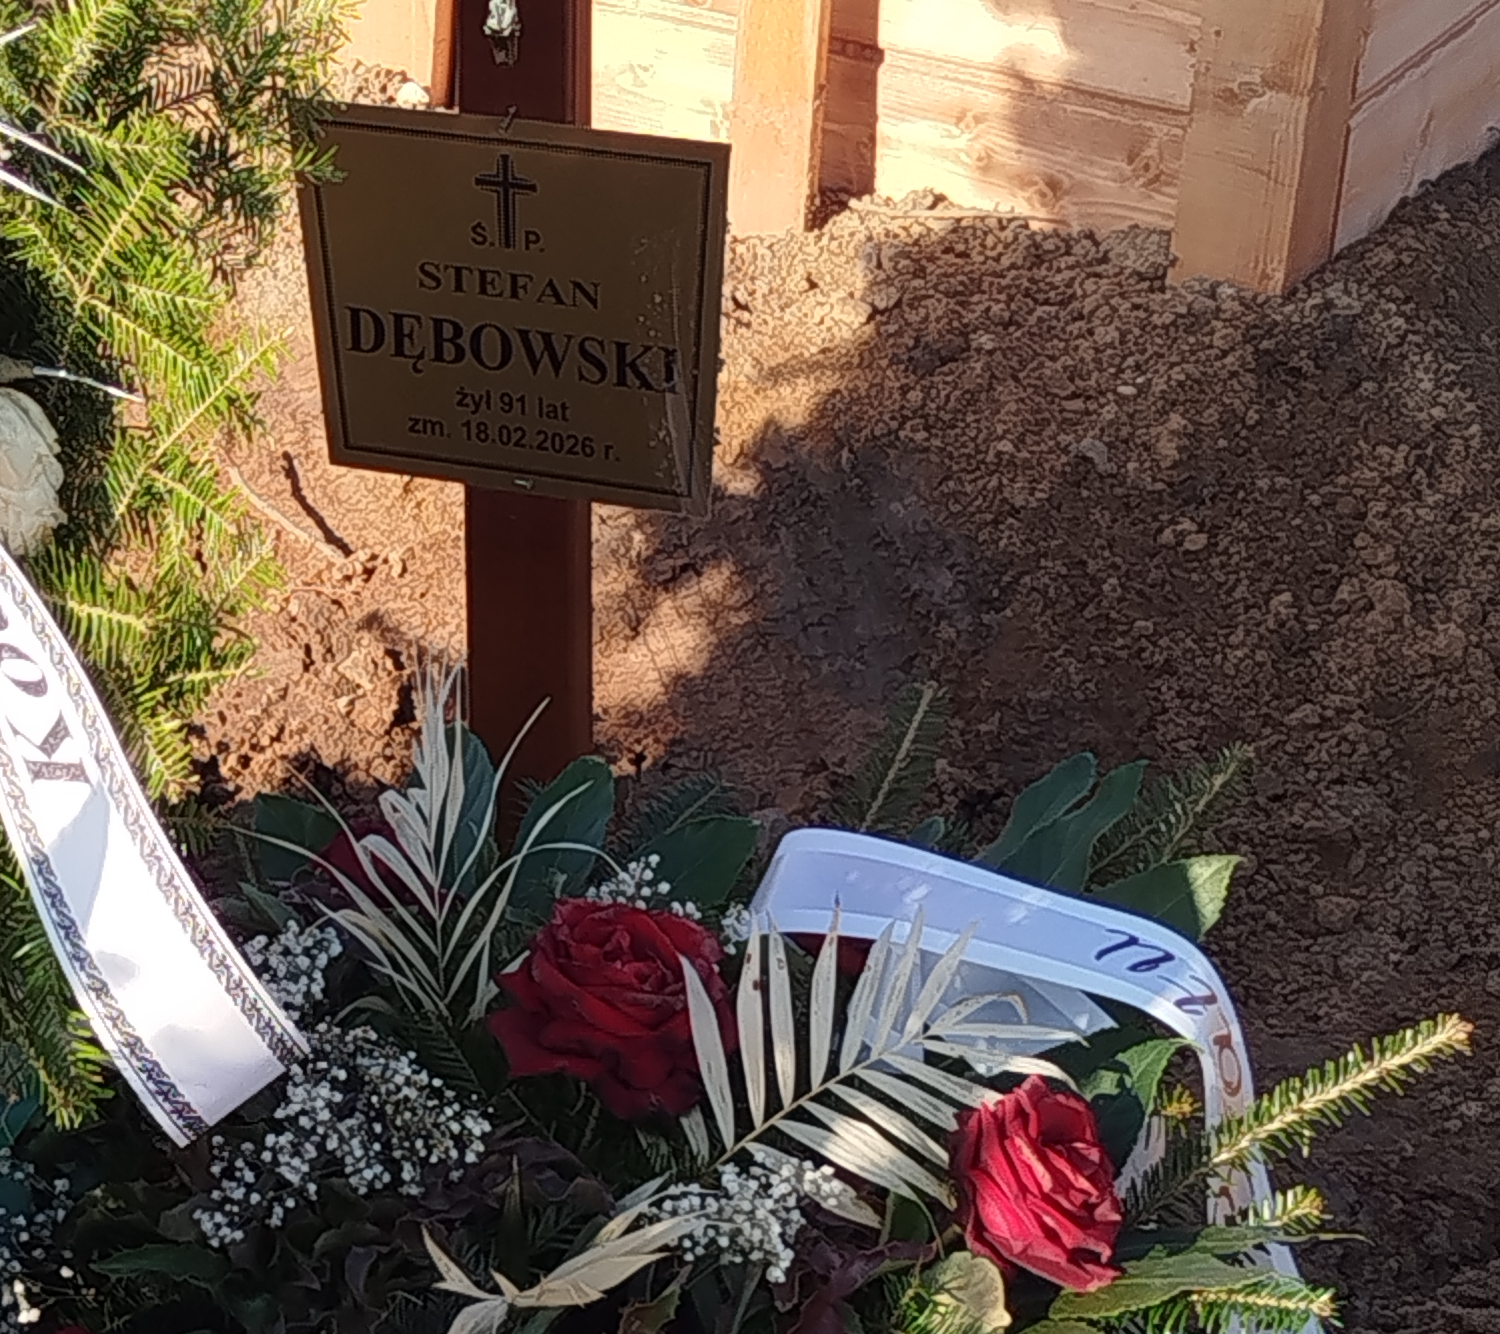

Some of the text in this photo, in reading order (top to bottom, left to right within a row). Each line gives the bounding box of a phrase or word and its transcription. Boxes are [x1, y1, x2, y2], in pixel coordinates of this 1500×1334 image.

[417, 260, 602, 312] STEFAN
[344, 305, 680, 395] DĘBOWSKI
[455, 385, 570, 424] żył 91 lat
[407, 414, 621, 462] zm. 18.02.2026 r.
